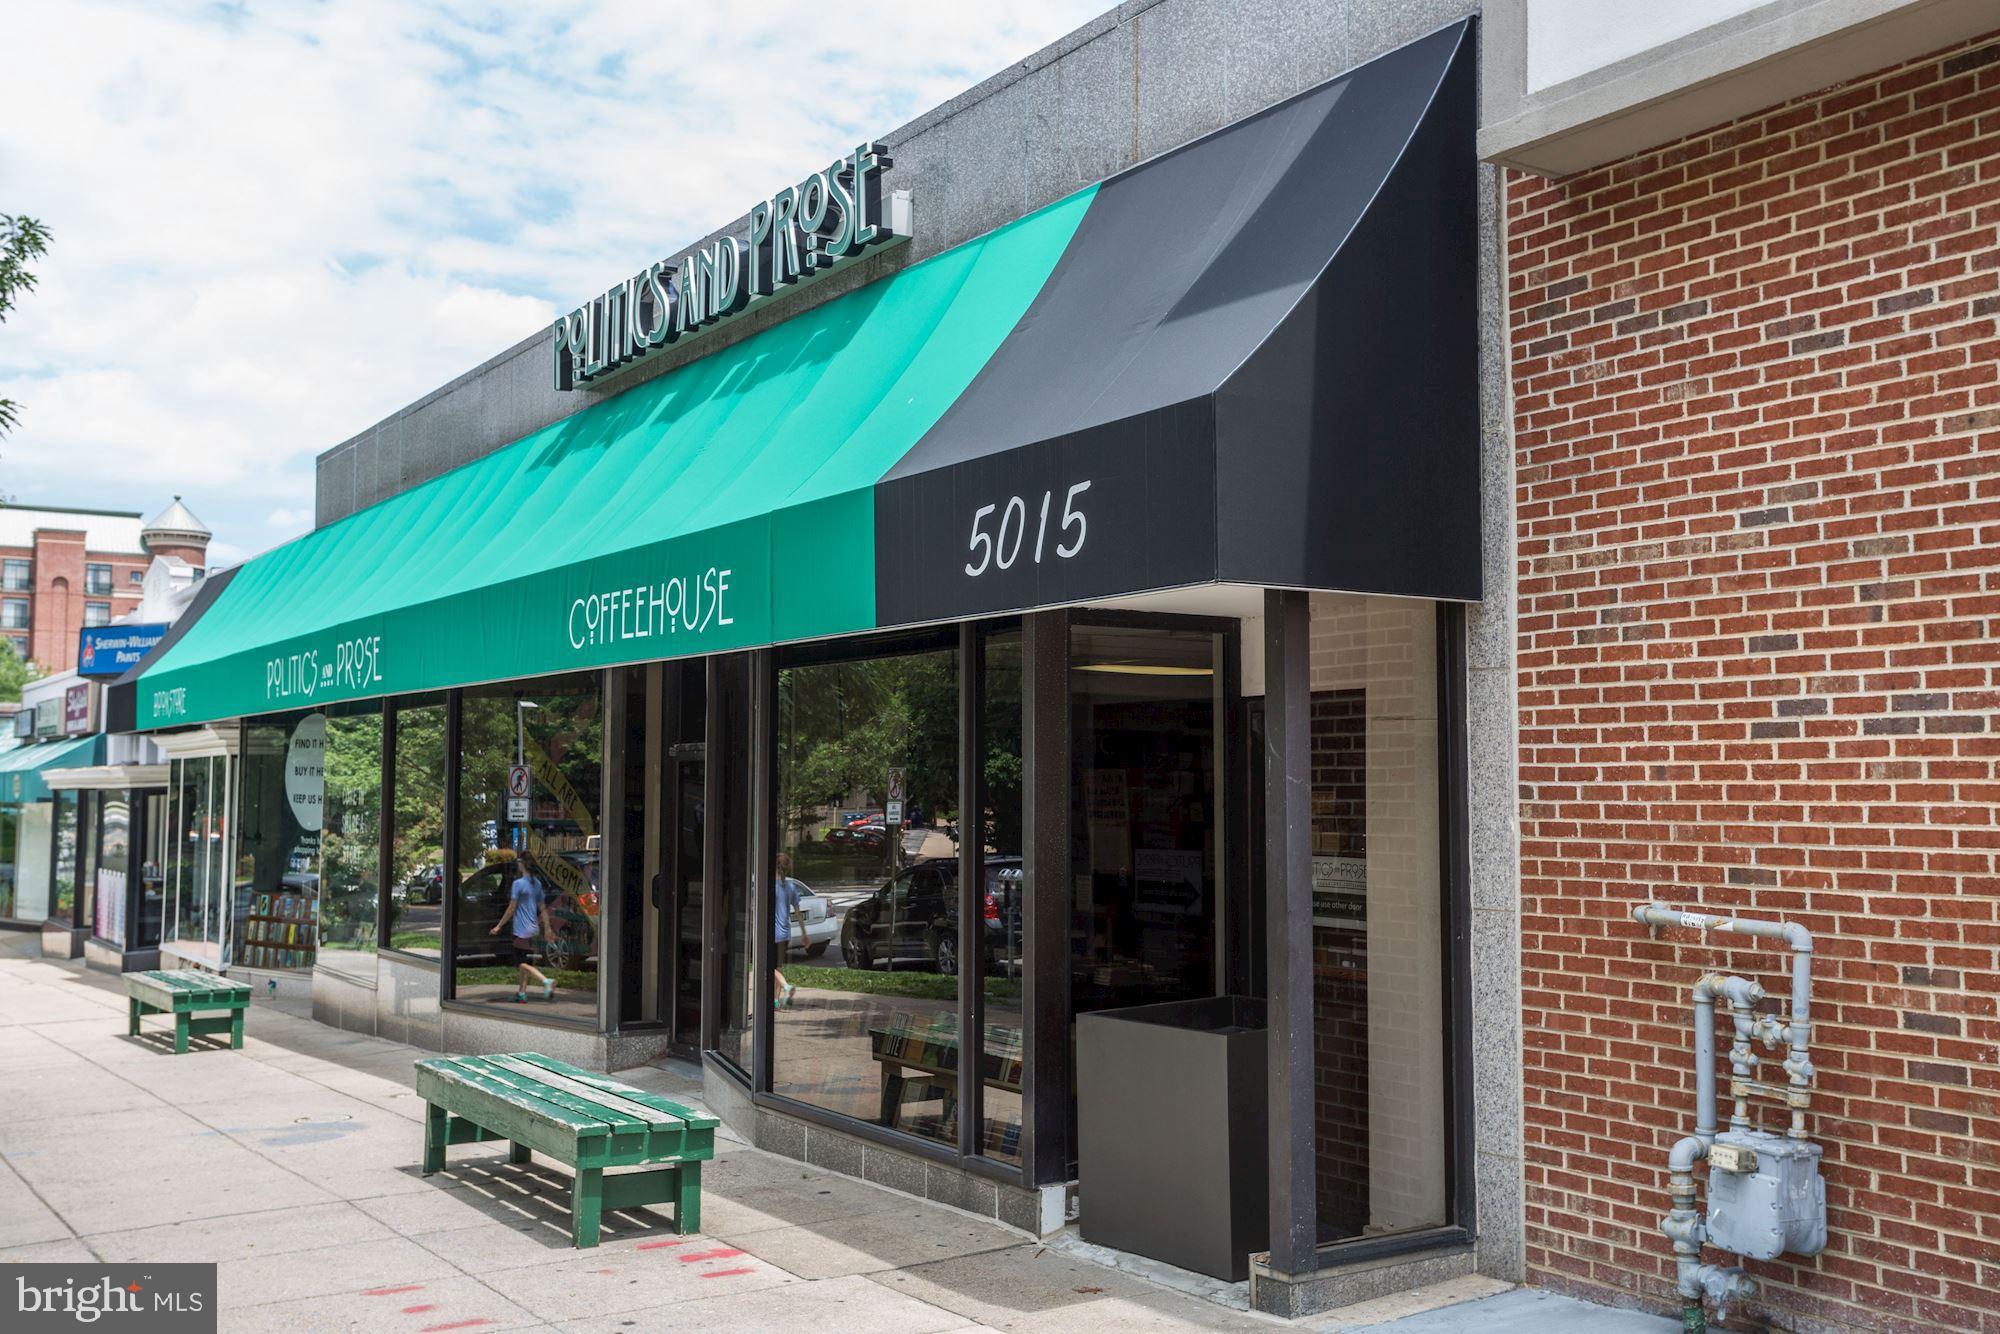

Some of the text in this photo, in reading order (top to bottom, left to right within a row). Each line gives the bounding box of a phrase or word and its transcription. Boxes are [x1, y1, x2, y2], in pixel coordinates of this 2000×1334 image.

[553, 141, 886, 391] POLITICS AND PROSE
[964, 480, 1092, 577] 5015
[568, 567, 734, 650] COFFEEHOUSE
[267, 649, 318, 699] POLITICS
[337, 636, 382, 690] PROSE
[295, 738, 311, 749] FIND
[312, 738, 318, 749] IT
[294, 766, 308, 776] BUY
[309, 766, 315, 776] IT
[539, 759, 578, 812] ALL ARE
[307, 794, 316, 804] US
[1331, 899, 1347, 910] other
[1347, 901, 1363, 912] door
